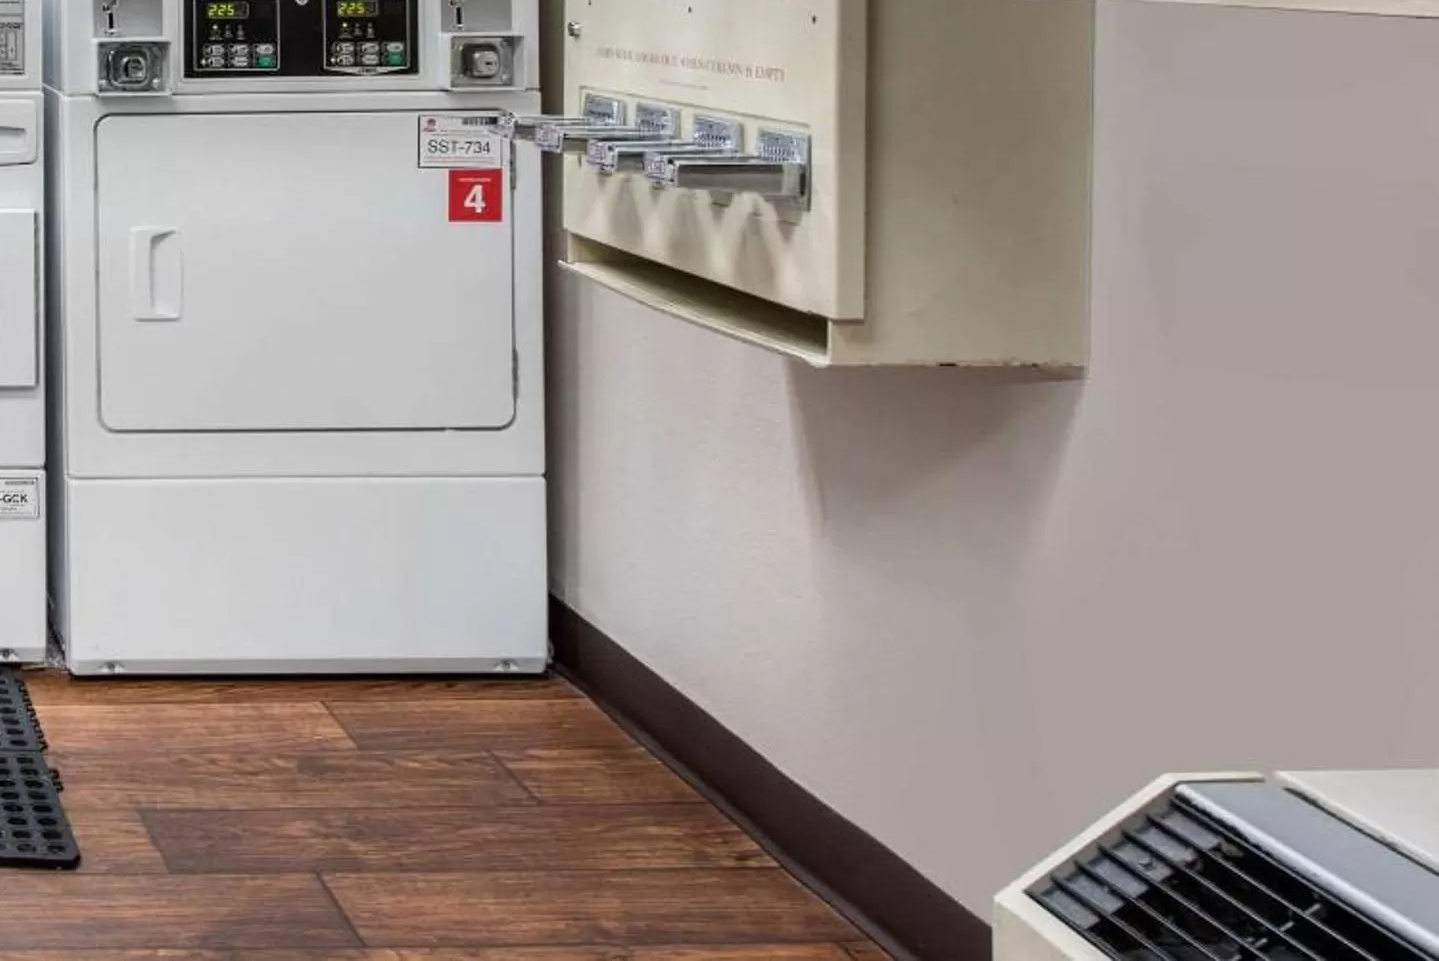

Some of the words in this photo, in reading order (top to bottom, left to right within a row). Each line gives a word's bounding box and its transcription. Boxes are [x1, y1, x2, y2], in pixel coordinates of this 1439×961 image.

[207, 4, 235, 16] 225
[427, 139, 491, 154] SST-734
[463, 183, 486, 214] 4
